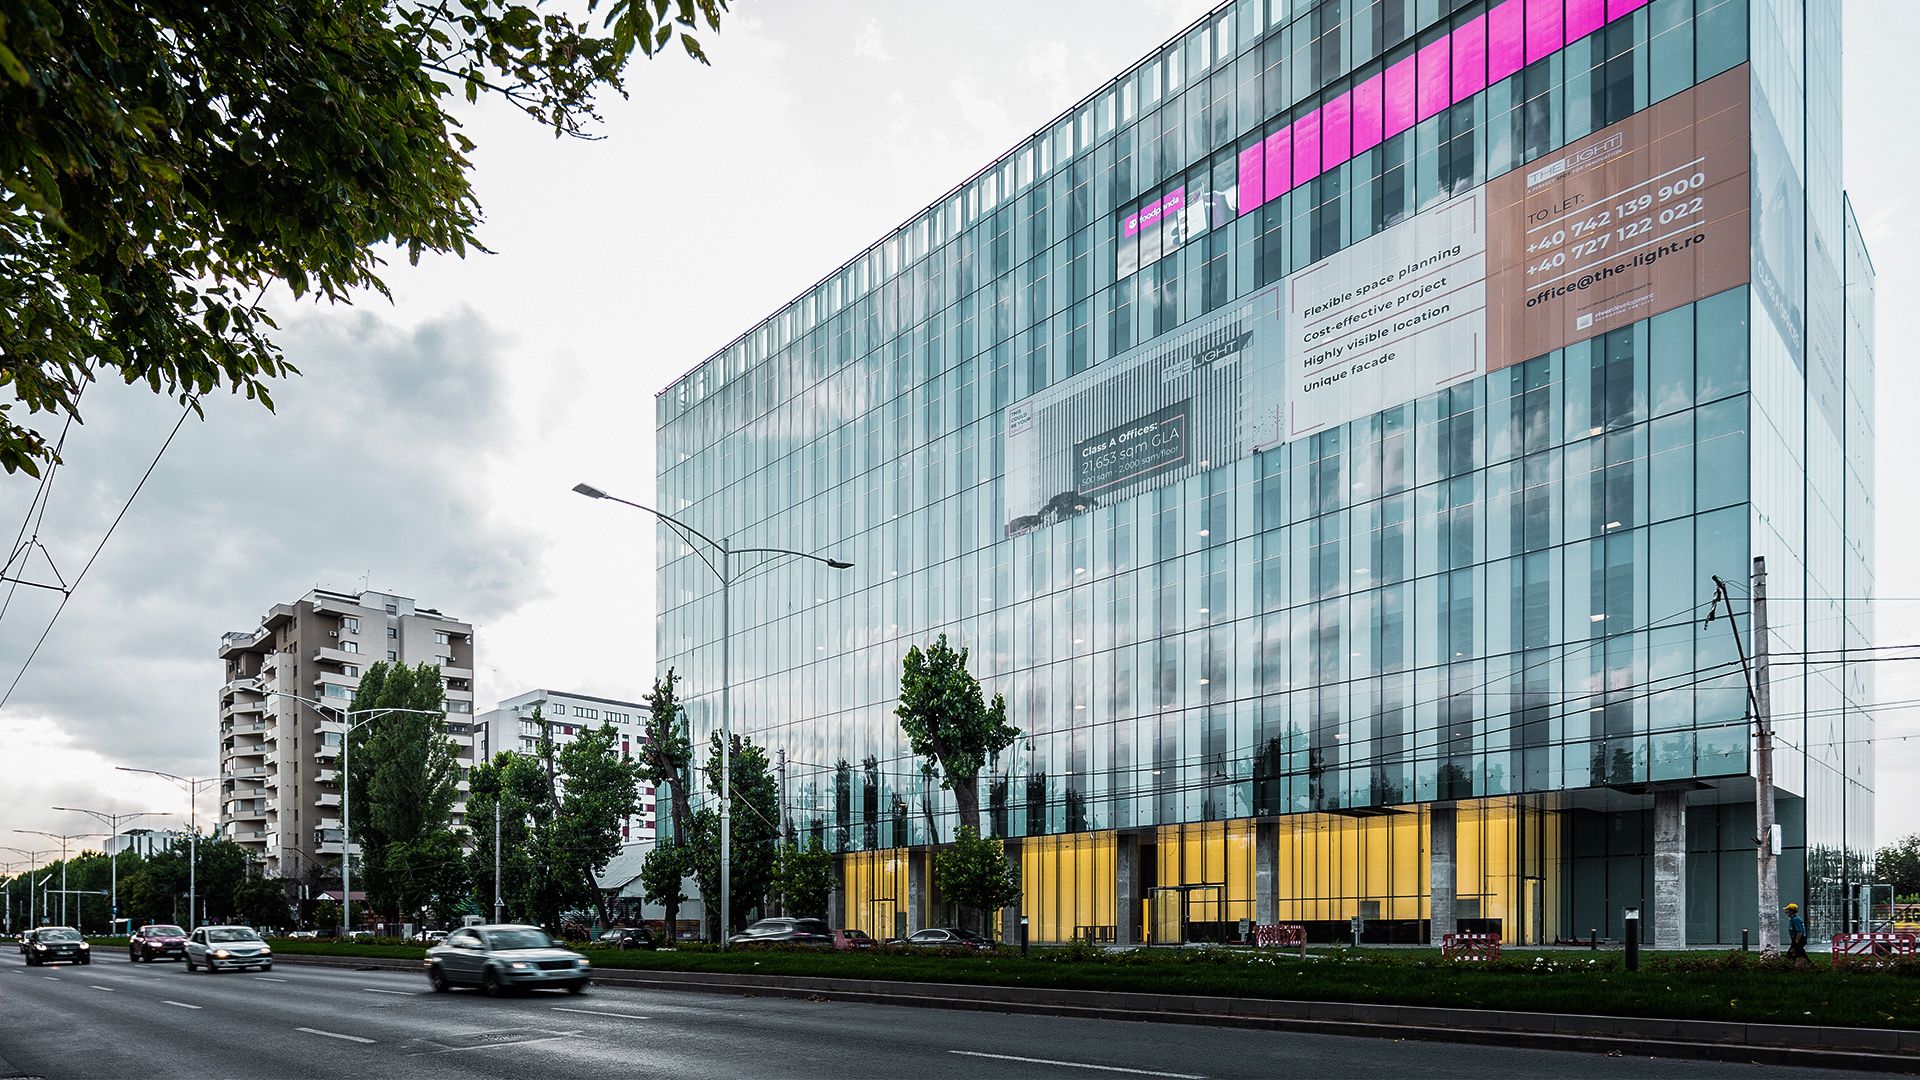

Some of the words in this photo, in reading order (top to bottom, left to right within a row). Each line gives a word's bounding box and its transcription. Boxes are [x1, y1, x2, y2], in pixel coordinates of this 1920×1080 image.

[1529, 161, 1564, 183] THE
[1566, 136, 1619, 167] LIGHT
[1527, 230, 1565, 253] +40
[1571, 212, 1610, 237] 742
[1616, 195, 1652, 219] 139
[1658, 172, 1705, 202] 900
[1528, 209, 1548, 224] TO
[1554, 193, 1584, 214] LET:
[1527, 252, 1565, 275] +40
[1572, 233, 1610, 260] 727
[1617, 218, 1652, 242] 122
[1659, 197, 1703, 225] 022
[1304, 291, 1352, 319] Flexible
[1355, 274, 1394, 299] space
[1399, 244, 1461, 280] planning
[1527, 233, 1705, 308] office@the-light.ro
[1304, 300, 1393, 343] Cost-effective
[1397, 277, 1447, 307] project
[1304, 343, 1343, 368] Highly
[1347, 326, 1389, 351] visible
[1393, 303, 1450, 333] location
[1163, 361, 1191, 379] THE
[1194, 340, 1237, 367] LIGHT
[1304, 370, 1347, 393] Unique
[1351, 352, 1396, 374] facade
[1082, 442, 1107, 457] Class
[1109, 438, 1116, 448] A
[1118, 422, 1158, 443] Offices:
[1082, 451, 1117, 474] 21,653
[1120, 441, 1148, 460] sqm
[1152, 427, 1179, 447] GLA
[1081, 475, 1096, 487] 500
[1097, 470, 1112, 482] sqm
[1141, 446, 1179, 465] sqm/floor
